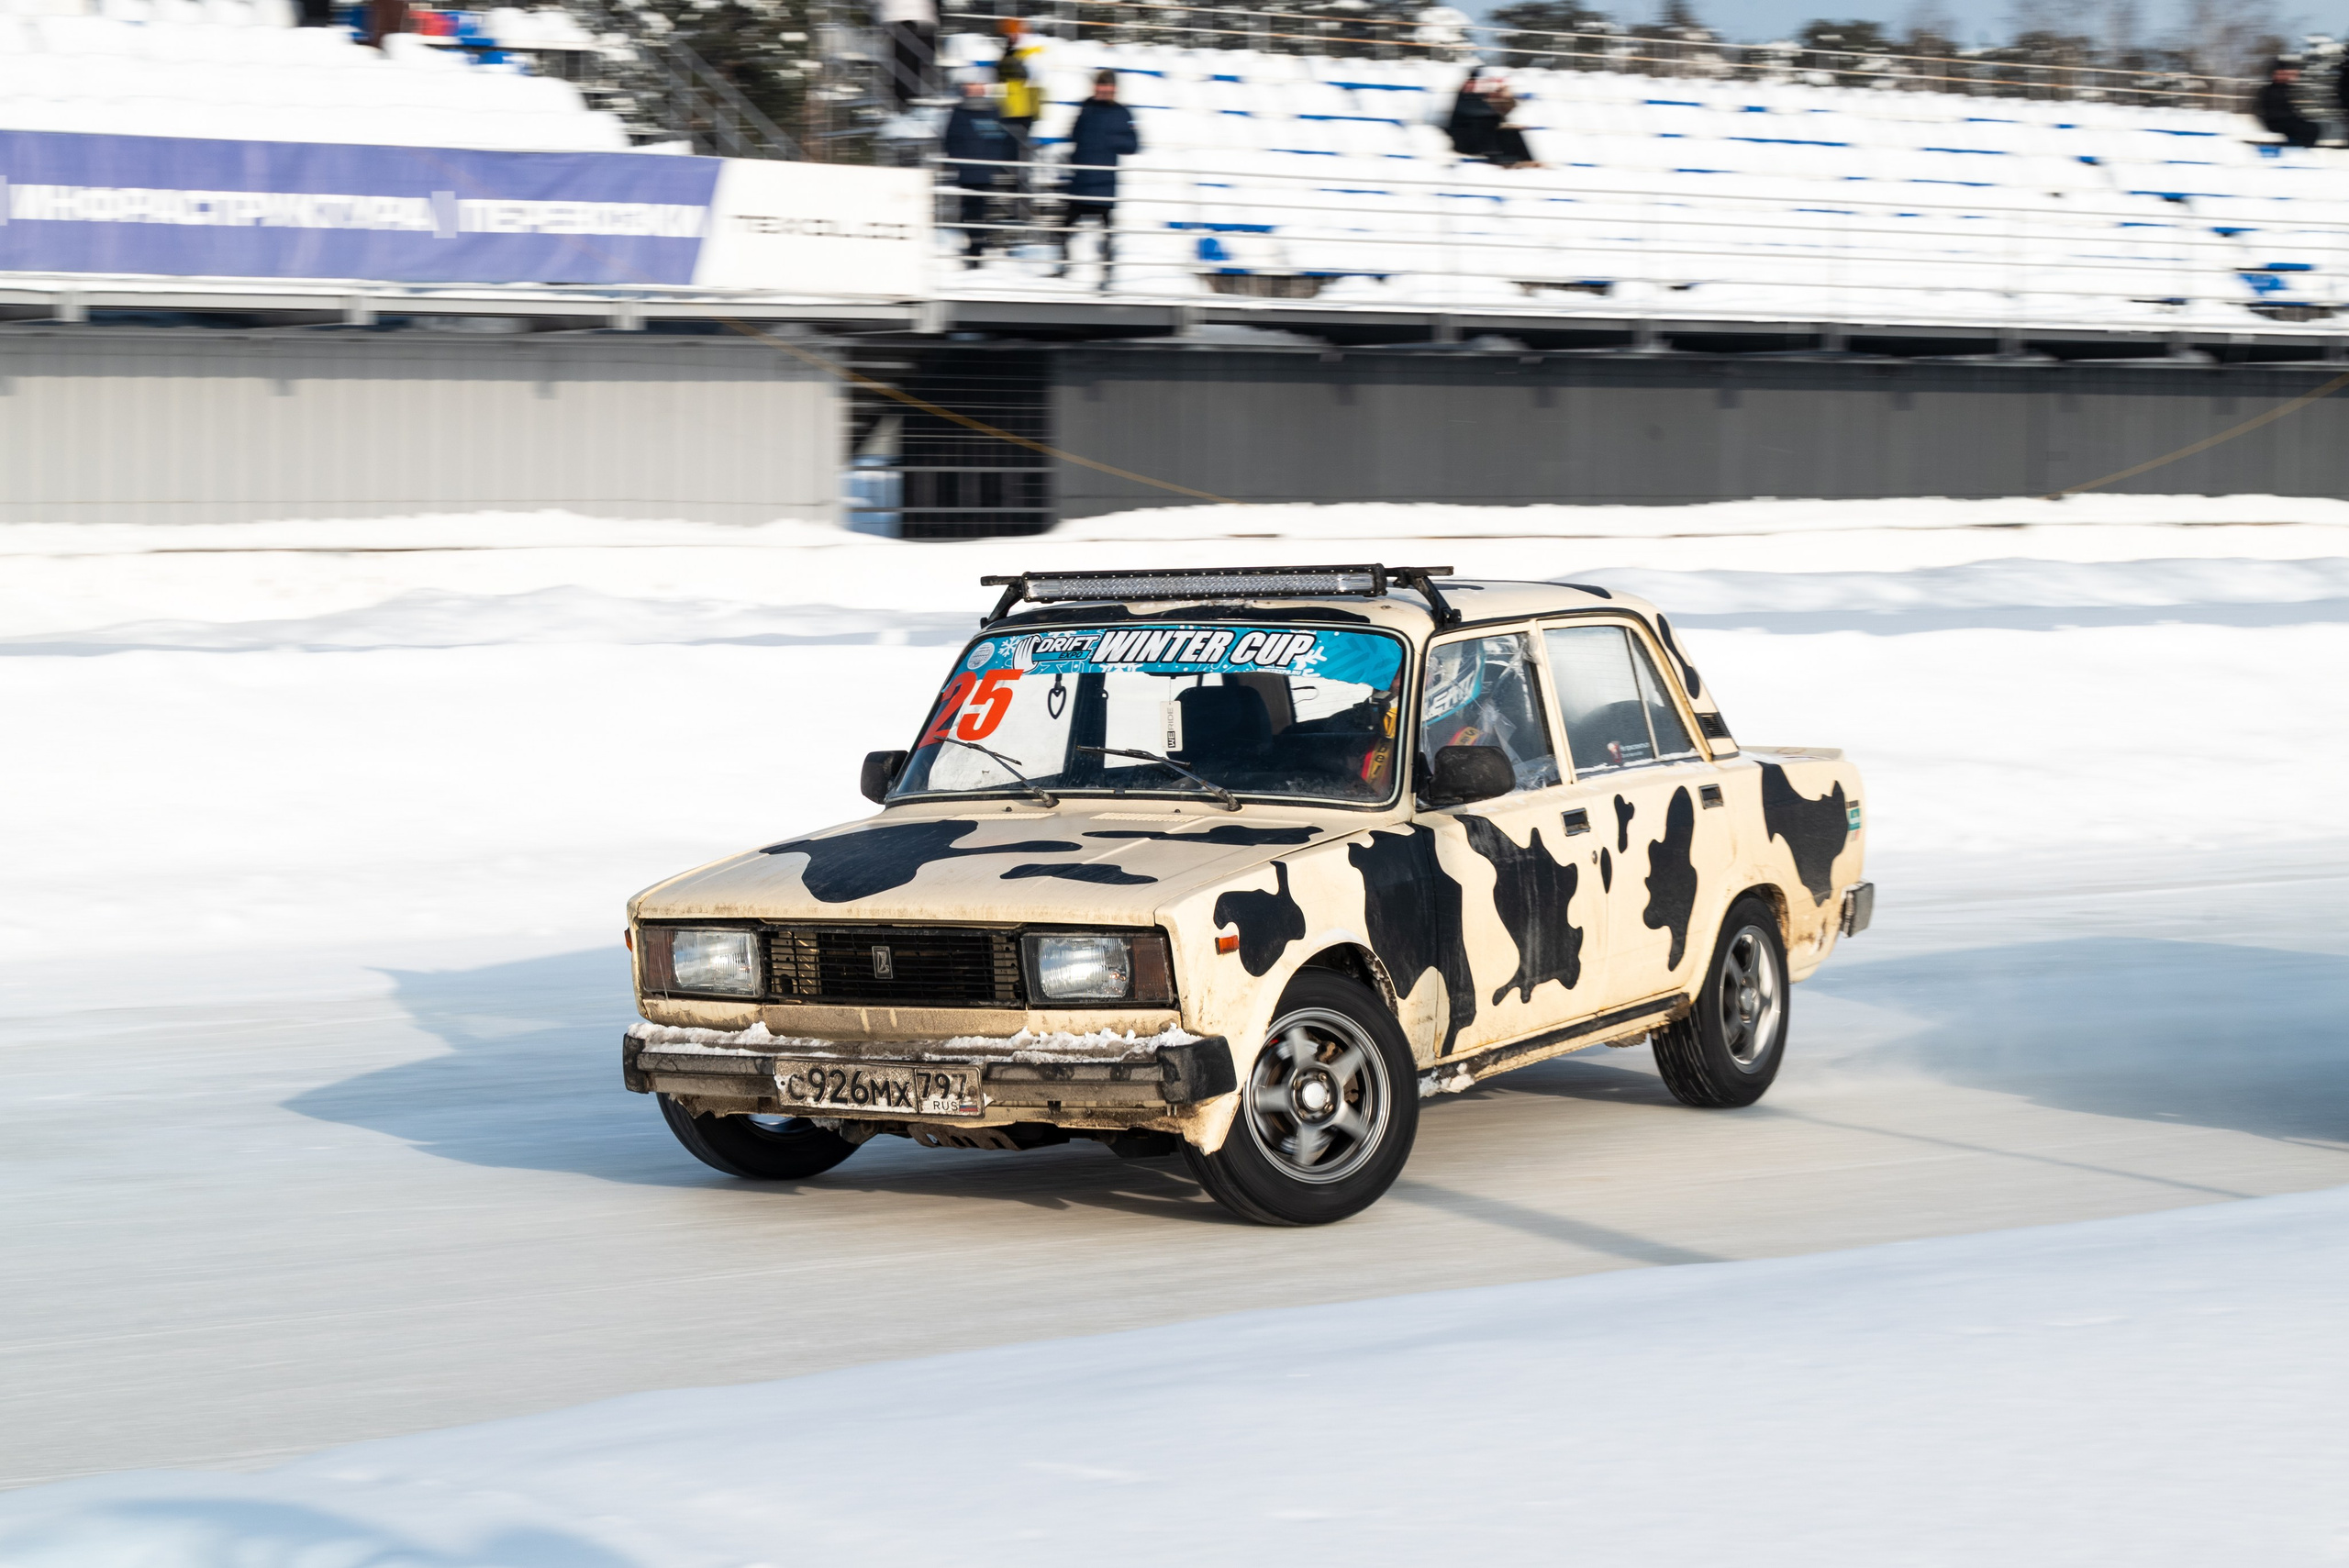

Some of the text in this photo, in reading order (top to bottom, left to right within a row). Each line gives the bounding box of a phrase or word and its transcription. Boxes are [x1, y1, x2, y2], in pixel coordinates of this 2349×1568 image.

[1035, 629, 1316, 667] DRIFT WINTER CUP
[918, 669, 1024, 750] 25
[918, 1073, 967, 1099] 797
[933, 1101, 958, 1111] RUS
